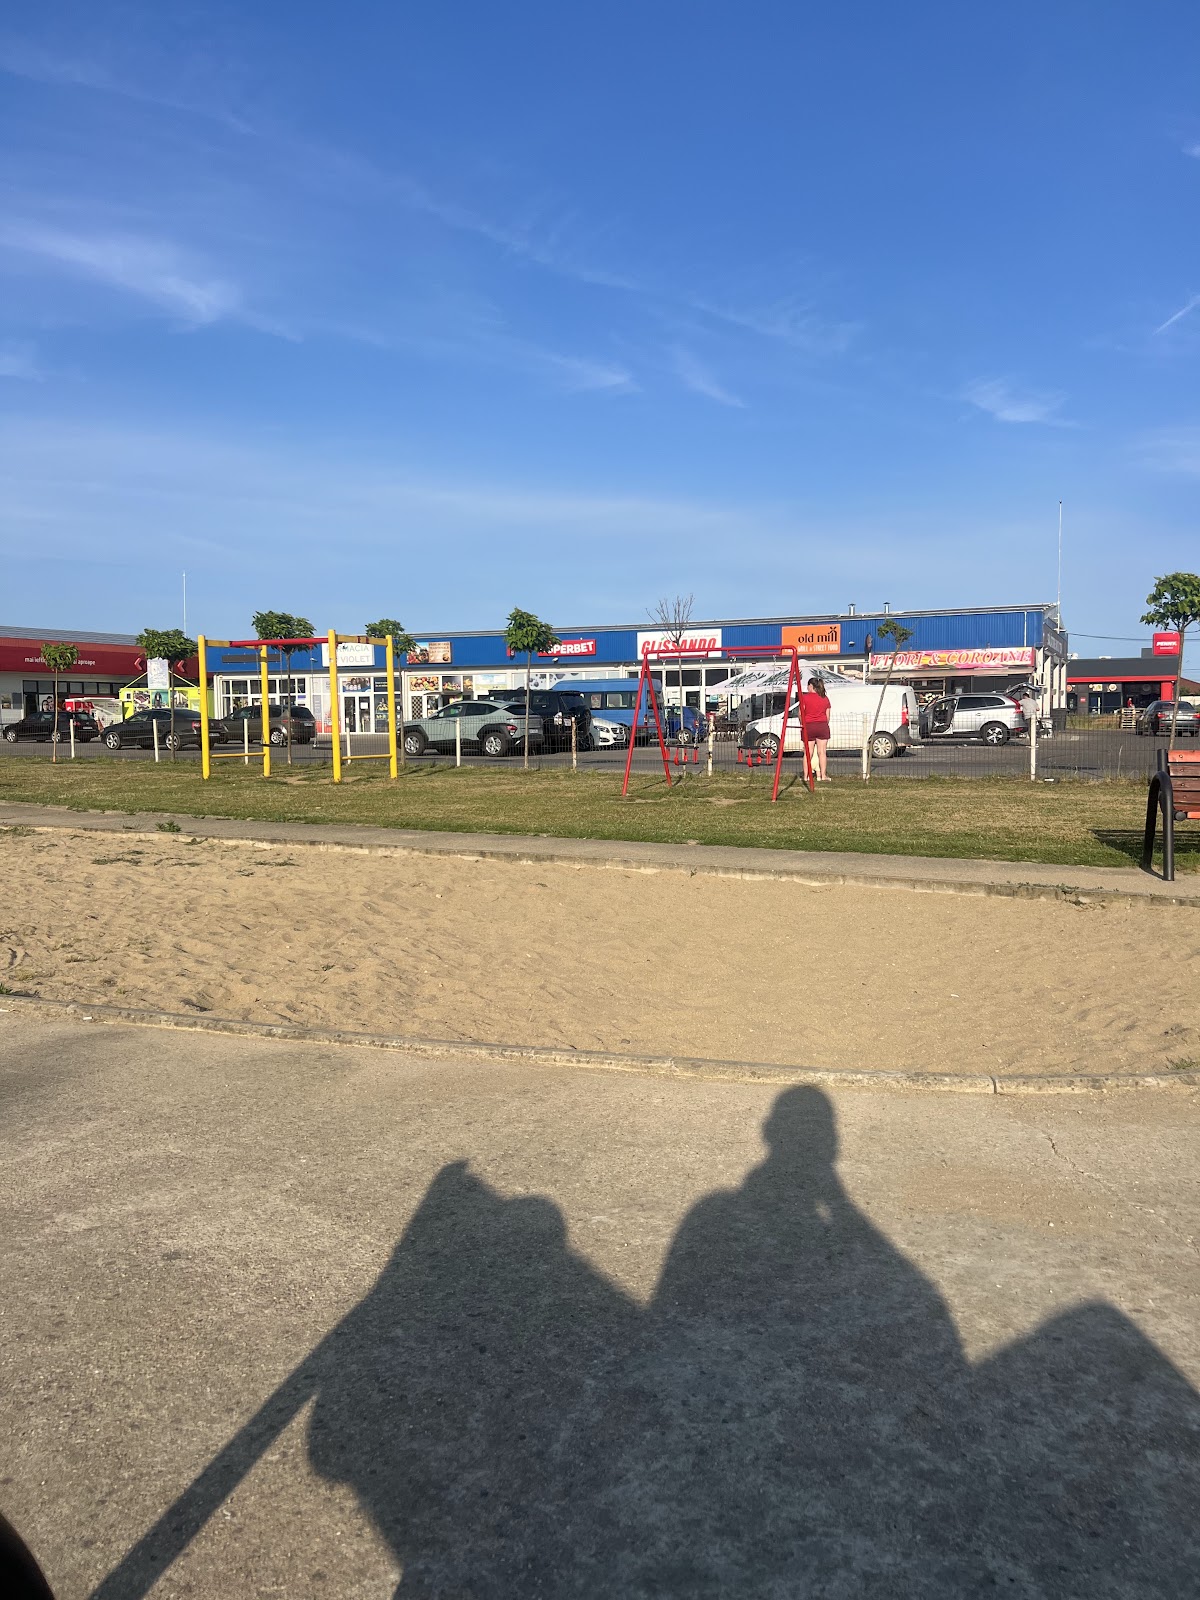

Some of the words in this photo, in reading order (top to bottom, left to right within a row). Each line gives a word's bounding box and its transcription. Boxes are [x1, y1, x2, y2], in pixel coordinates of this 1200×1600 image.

[797, 633, 814, 644] old
[817, 629, 837, 643] mill
[547, 641, 594, 655] PERBET
[827, 643, 839, 652] FOOD
[340, 655, 371, 664] VIOLET
[928, 652, 940, 666] &
